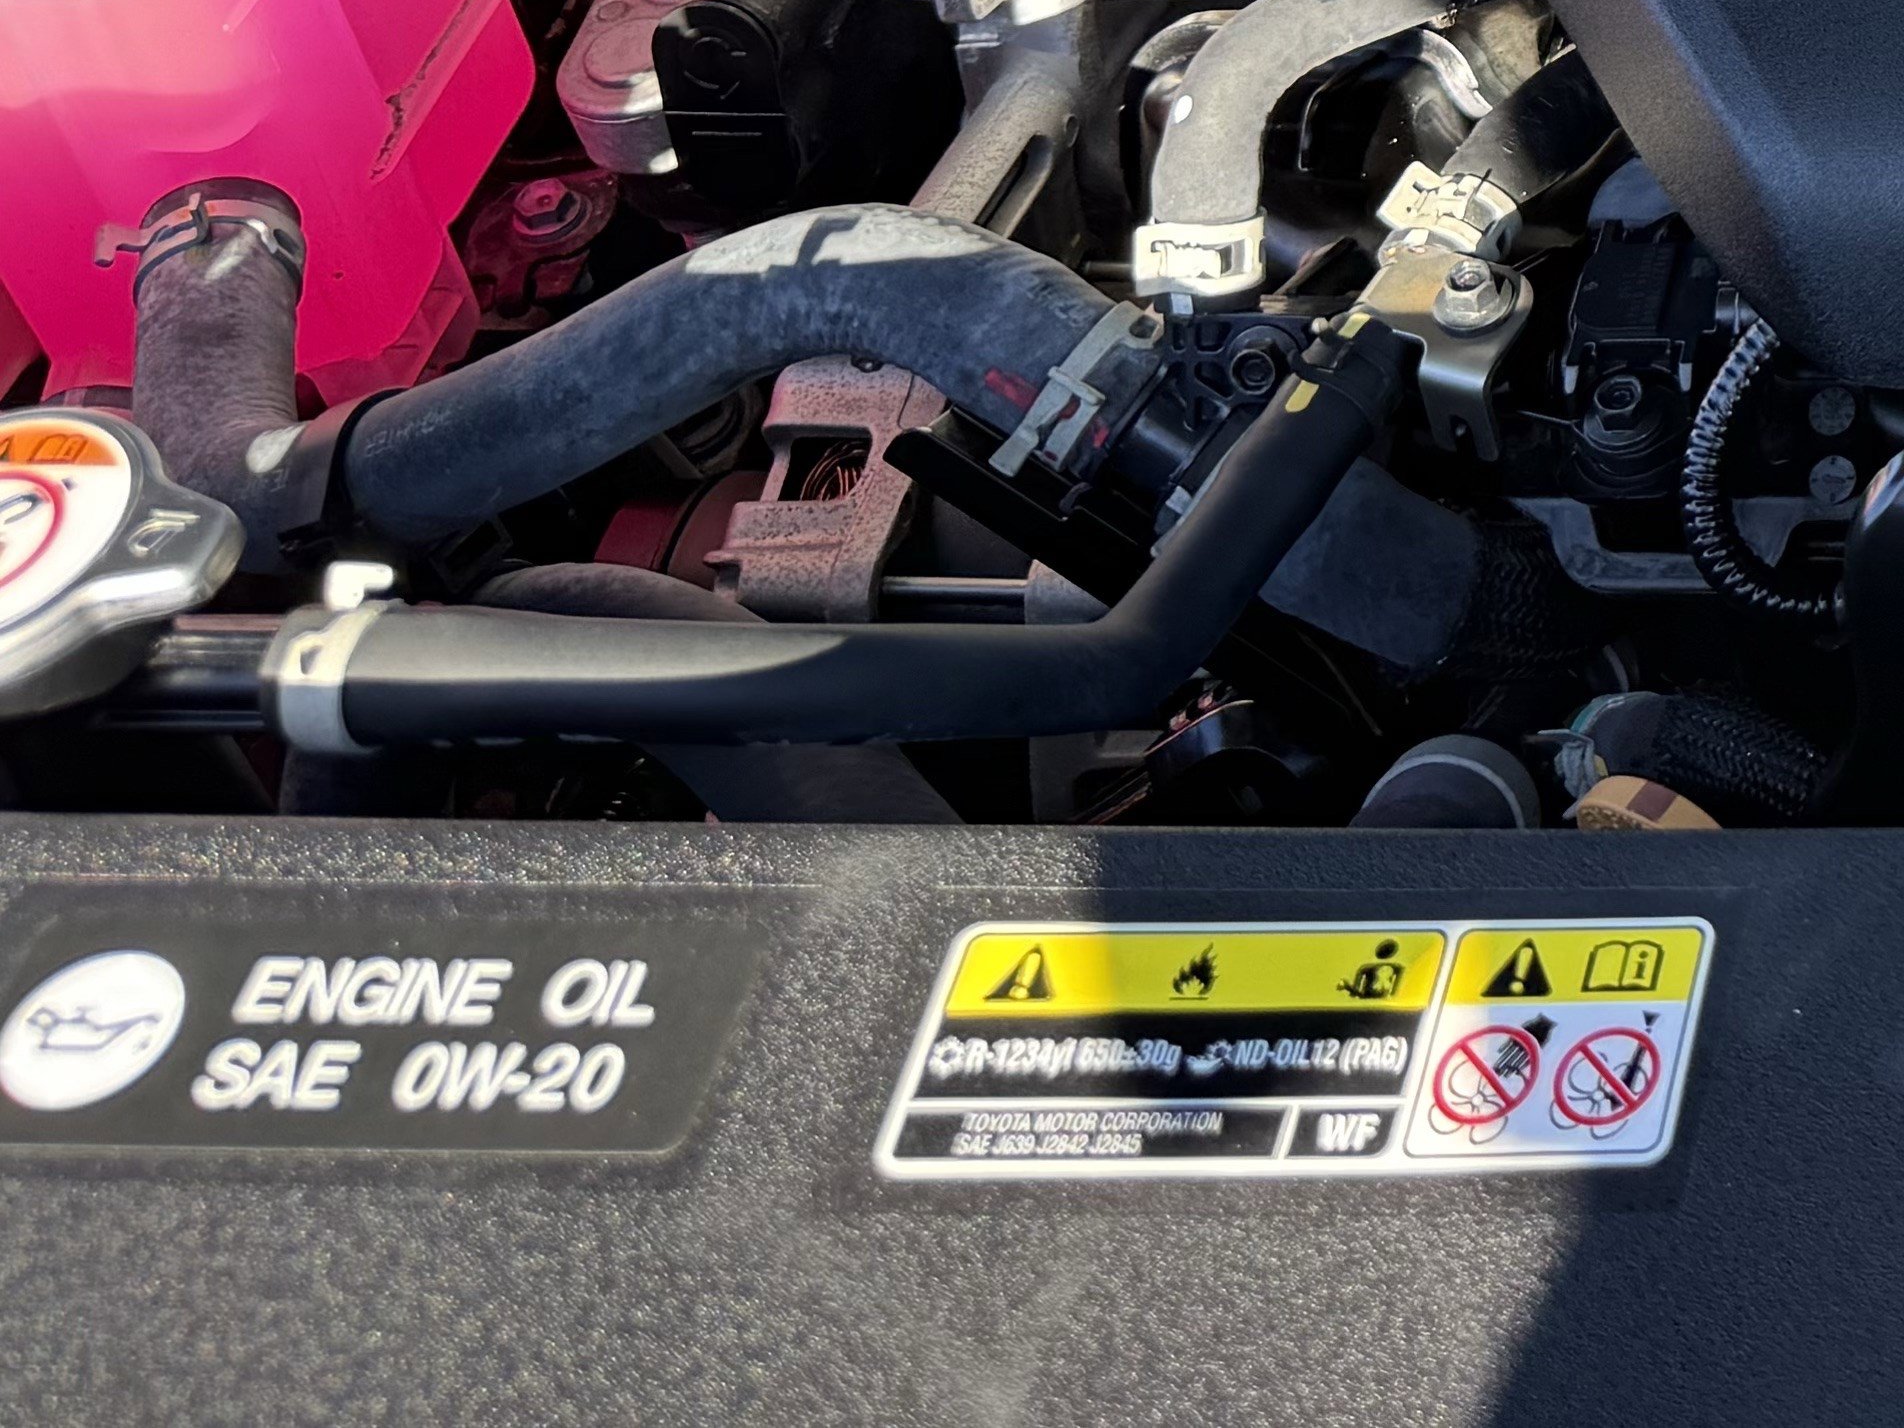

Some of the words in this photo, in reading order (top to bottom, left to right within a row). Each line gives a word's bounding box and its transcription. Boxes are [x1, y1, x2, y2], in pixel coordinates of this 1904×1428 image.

[232, 955, 513, 1026] ENGINE
[541, 957, 655, 1028] OIL
[191, 1038, 362, 1112] SAE
[391, 1040, 626, 1114] 0W-20
[962, 1110, 1032, 1133] TOYOTA
[1033, 1111, 1099, 1134] MOTOR
[1100, 1111, 1224, 1136] CORPORATION
[1316, 1113, 1381, 1152] WF
[953, 1132, 993, 1156] SAE
